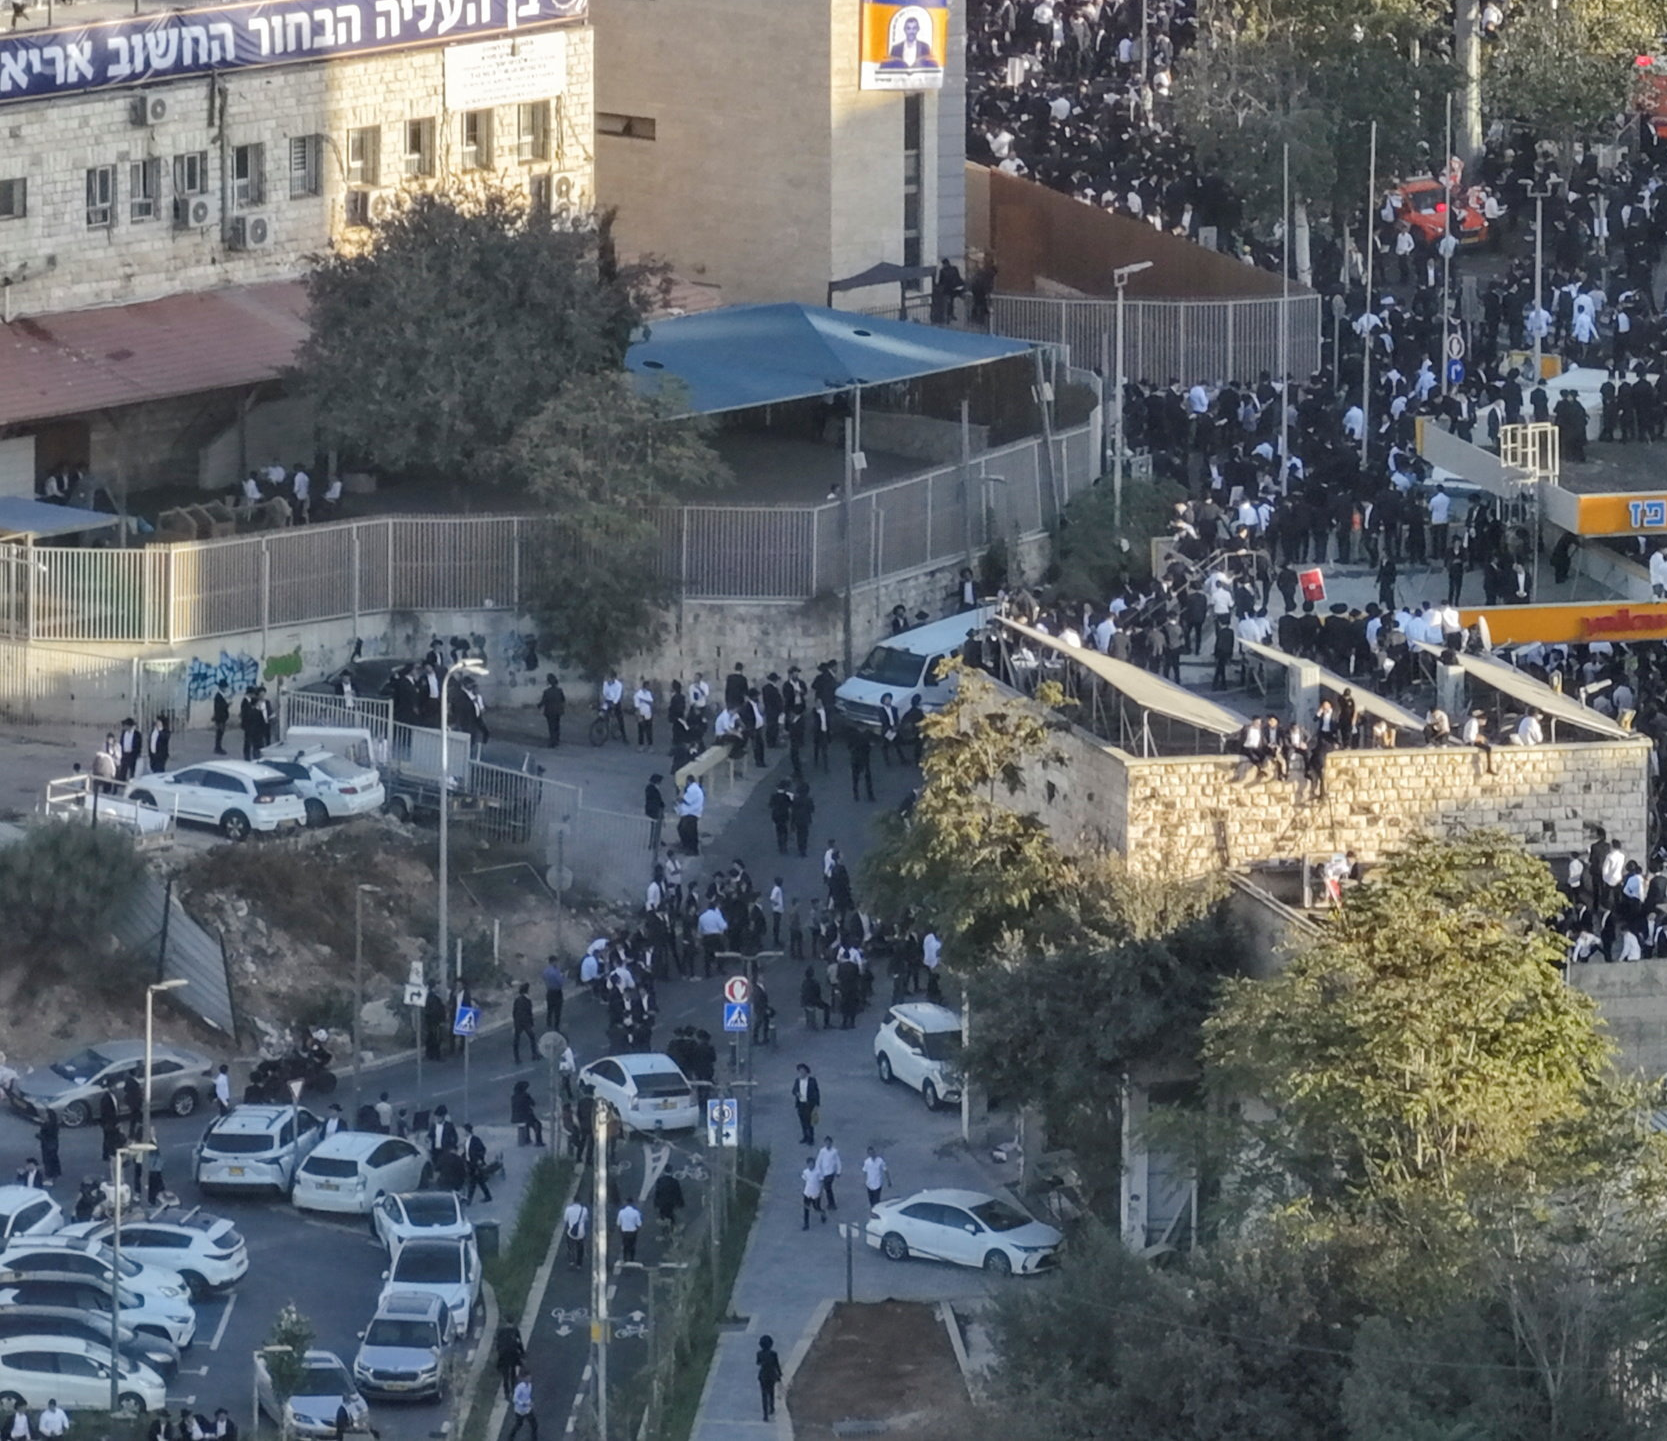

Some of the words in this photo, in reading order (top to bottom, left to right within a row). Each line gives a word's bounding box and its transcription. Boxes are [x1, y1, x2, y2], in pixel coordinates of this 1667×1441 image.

[106, 22, 236, 77] החשוב
[248, 5, 363, 56] הבחור
[1628, 498, 1667, 528] פז
